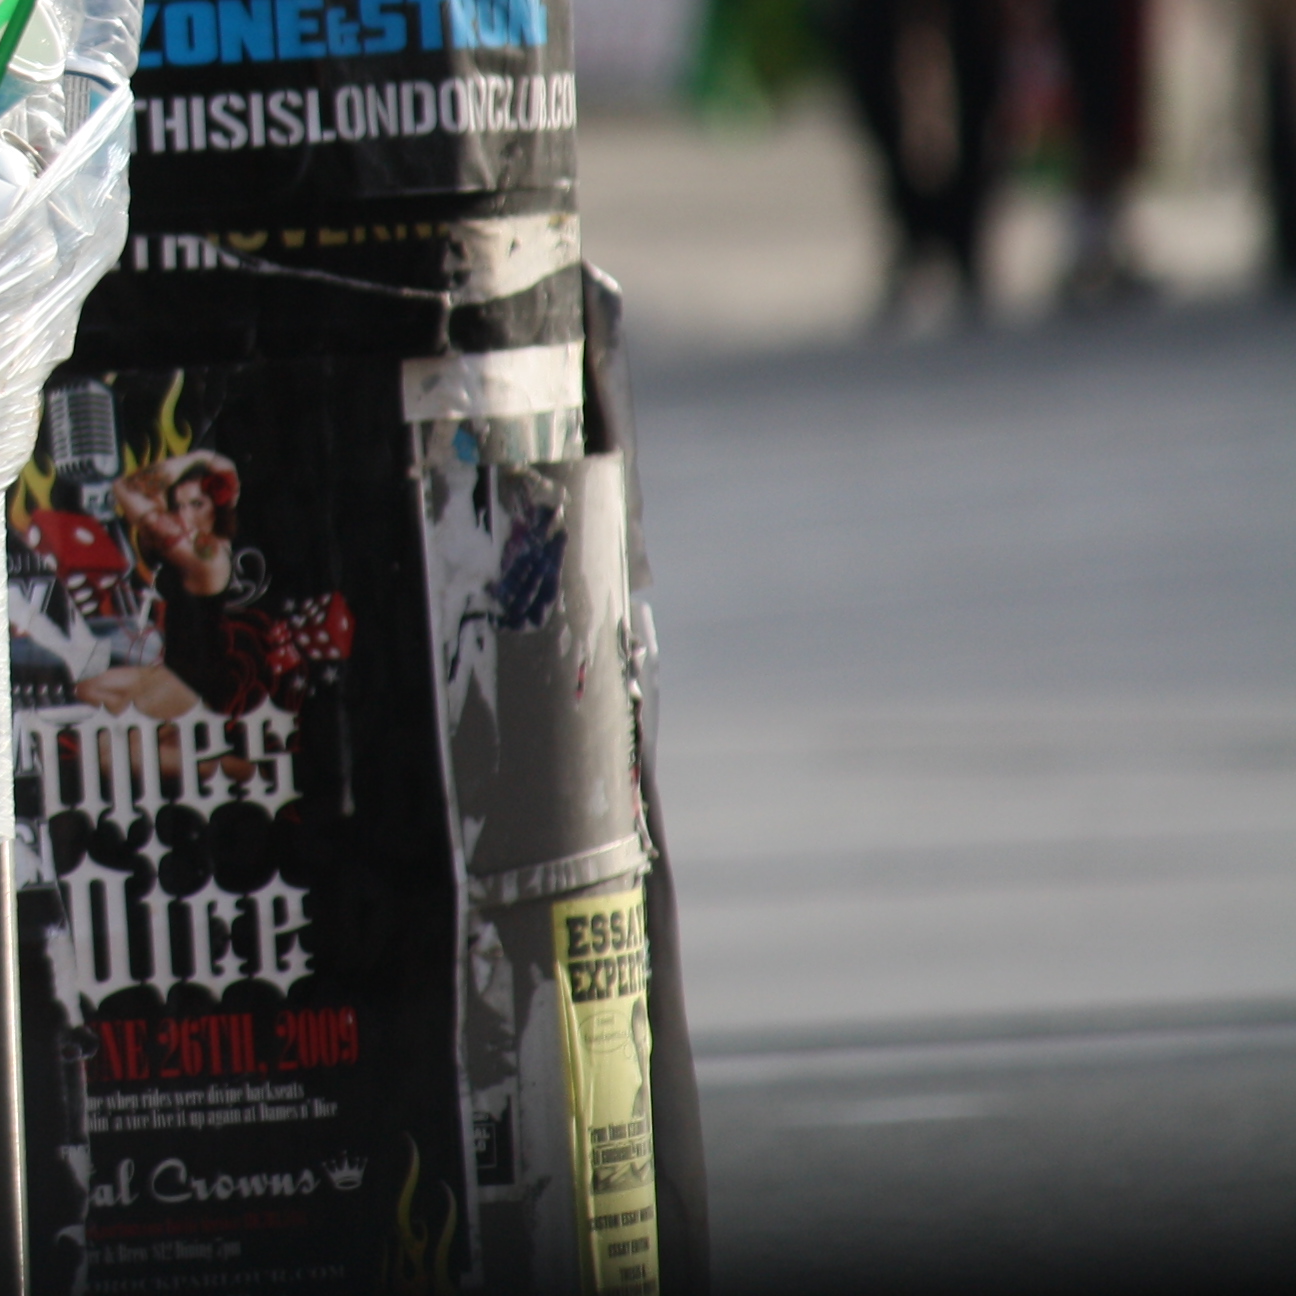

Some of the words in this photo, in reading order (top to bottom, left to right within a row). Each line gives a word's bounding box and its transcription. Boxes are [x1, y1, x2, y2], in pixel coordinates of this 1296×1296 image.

[160, 1010, 270, 1081] 26TH,
[275, 1004, 360, 1072] 2009
[150, 1156, 323, 1203] Crowns
